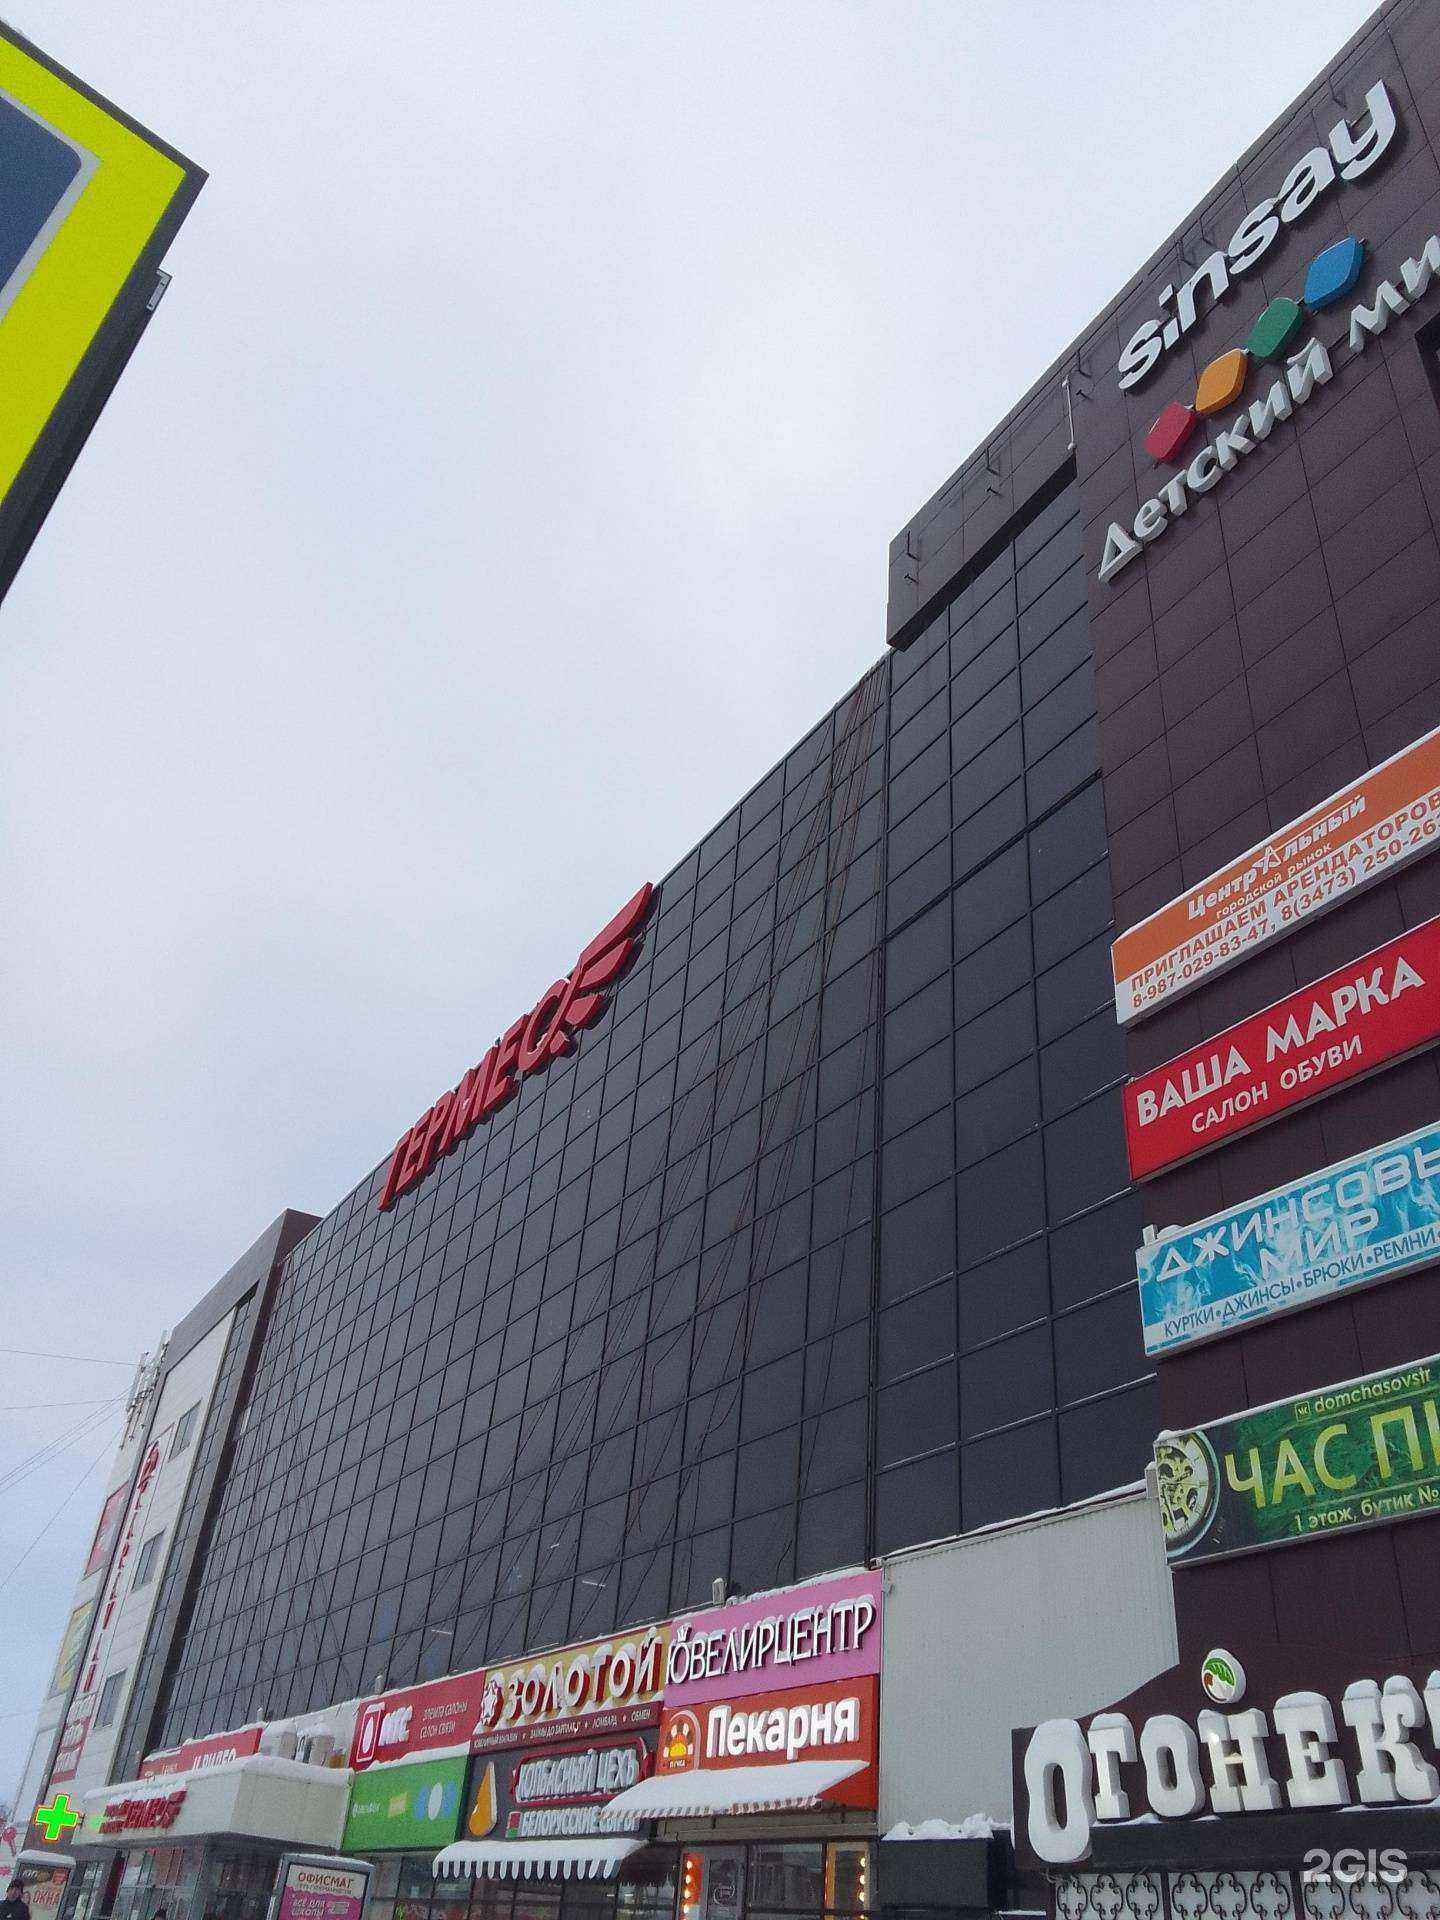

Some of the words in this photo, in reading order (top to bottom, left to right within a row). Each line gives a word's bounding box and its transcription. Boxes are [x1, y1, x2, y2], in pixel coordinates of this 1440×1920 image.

[1118, 80, 1396, 389] sinsay
[1099, 337, 1333, 583] Детский
[1216, 872, 1281, 919] городской
[1287, 843, 1331, 878] рынок
[1281, 867, 1356, 921] 8(3473)
[1131, 901, 1266, 991] ПРИГЛАШАЕМ
[1136, 1045, 1251, 1127] ВАША
[1266, 956, 1425, 1063] МАРКА
[1191, 1081, 1269, 1134] САЛОН
[1280, 1035, 1363, 1090] ОБУВИ
[1164, 1306, 1215, 1338] КУРТКИ
[1222, 1278, 1295, 1320] ДЖИНСЫ
[1304, 1254, 1364, 1288] БРЮКИ
[1374, 1227, 1436, 1265] РЕМНИ
[1260, 1207, 1379, 1281] МИР
[1225, 1424, 1356, 1508] ЧАС
[1361, 1493, 1417, 1517] бутик
[508, 1628, 663, 1718] ЗОЛОТОЙ
[665, 1602, 874, 1685] ЮВЕЛИРЦЕНТР
[706, 1698, 859, 1760] Пекарня
[298, 1872, 354, 1889] ОФИСМАГ
